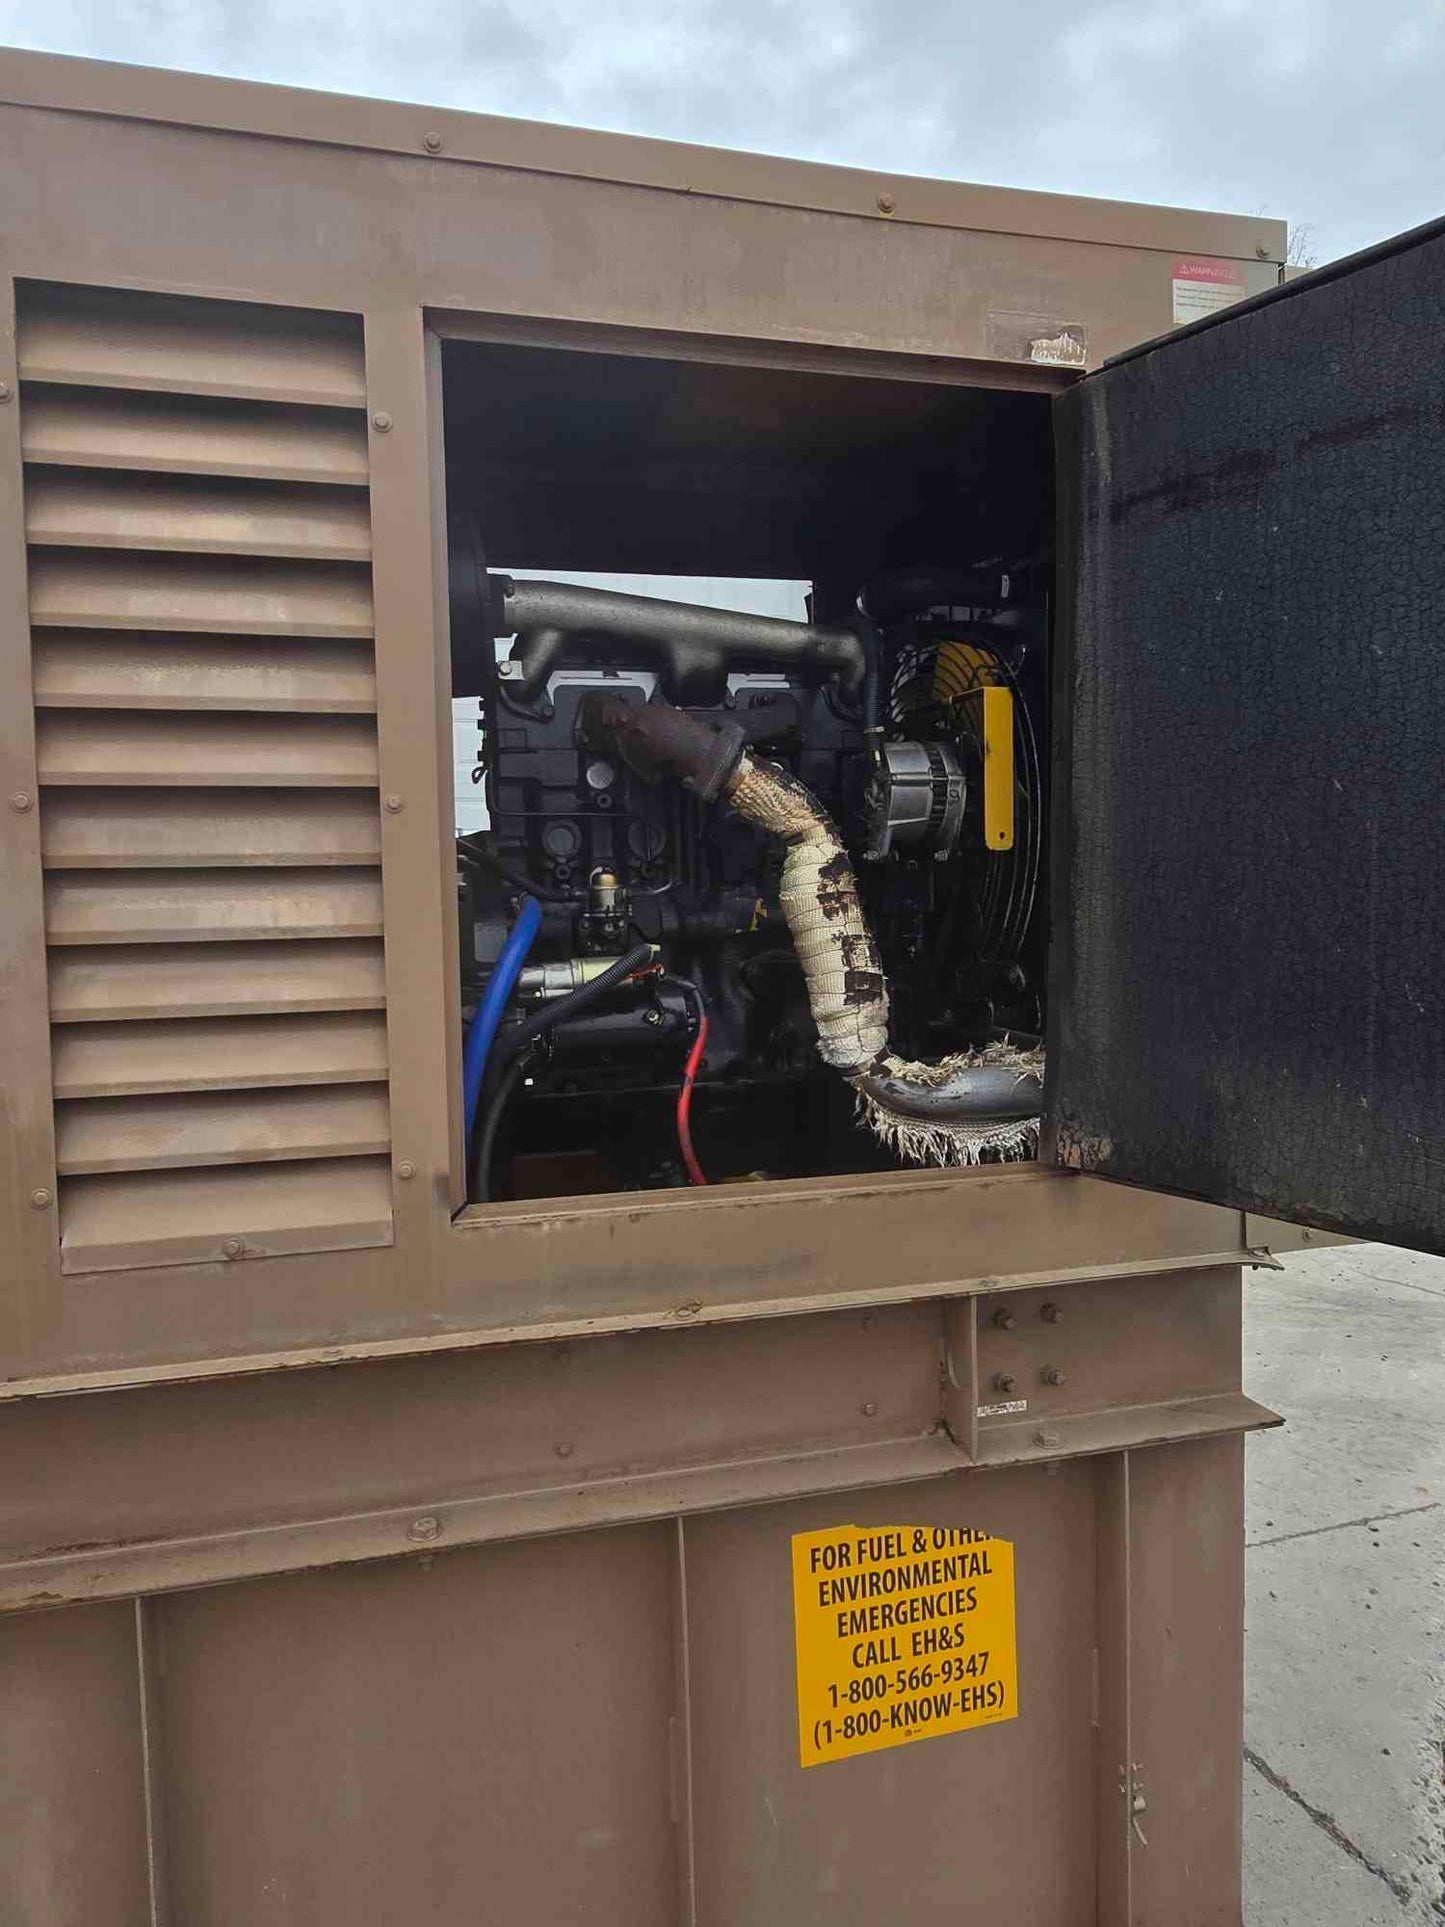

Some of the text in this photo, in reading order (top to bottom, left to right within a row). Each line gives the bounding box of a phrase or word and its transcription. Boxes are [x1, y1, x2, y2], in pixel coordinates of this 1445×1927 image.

[810, 1528, 992, 1572] FOR FUEL & OTHE
[818, 1551, 992, 1606] ENVIRONMENTAL
[837, 1587, 977, 1638] EMERGENCIES
[852, 1623, 965, 1668] CALL EH&S
[828, 1651, 990, 1708] 1-800-566-9347
[813, 1680, 1005, 1750] (1-800-KNOW-EHS)
